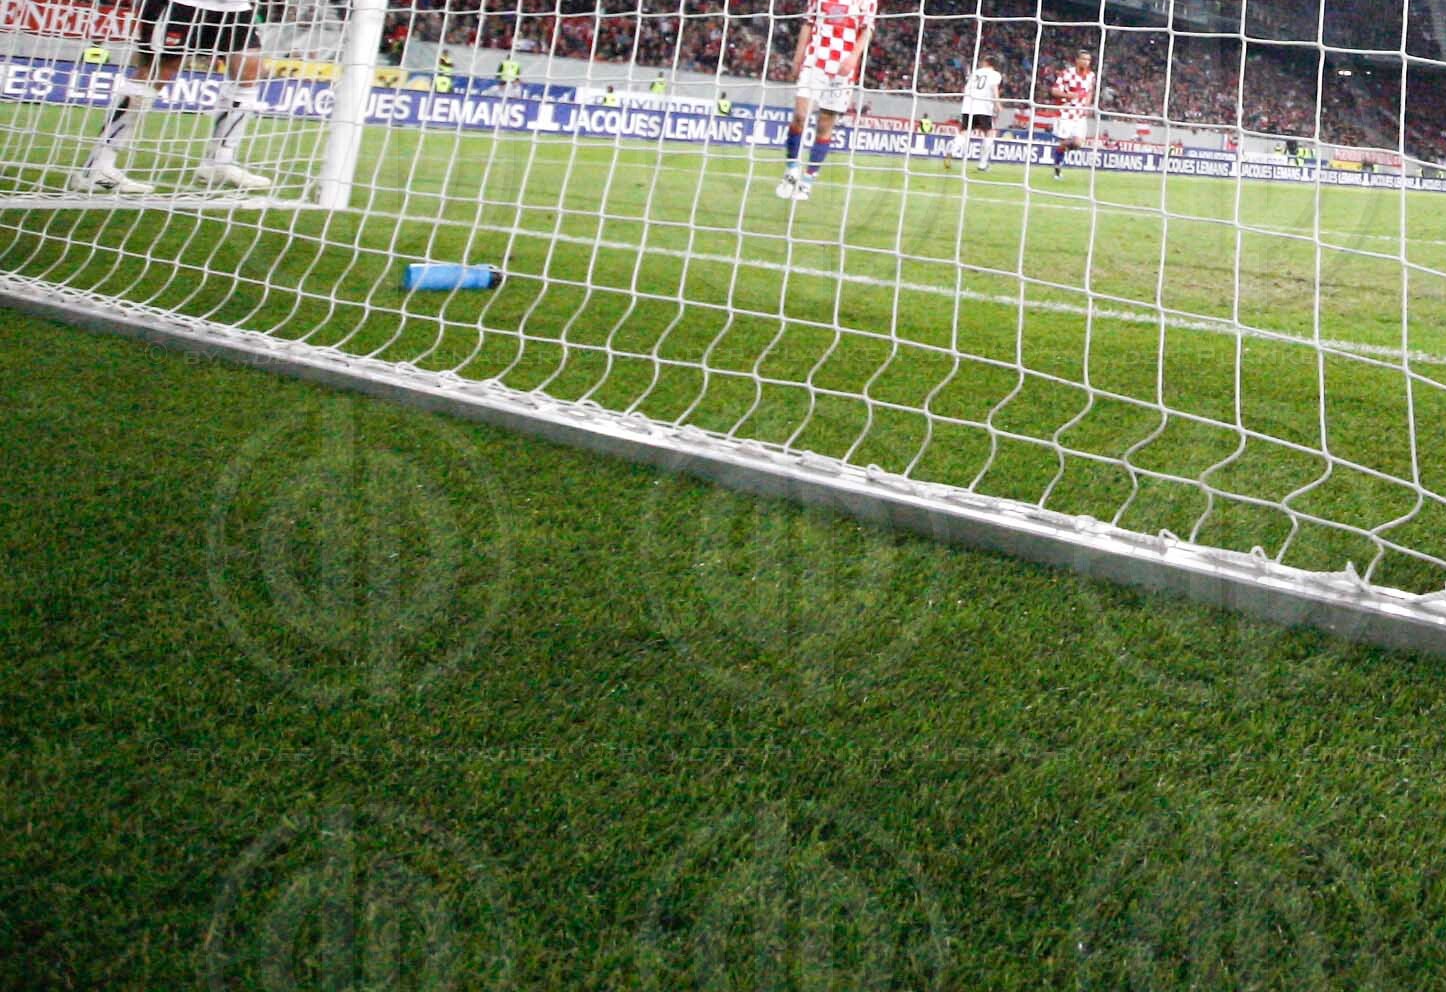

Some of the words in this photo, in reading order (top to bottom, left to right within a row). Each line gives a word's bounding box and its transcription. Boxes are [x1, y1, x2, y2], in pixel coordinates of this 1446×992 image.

[417, 96, 526, 129] LEMANS
[562, 108, 660, 139] JACQUES
[664, 116, 744, 143] LEMANS
[848, 128, 909, 154] LEMANS
[993, 142, 1040, 163] LEMANS
[1103, 152, 1143, 171] LEMANS
